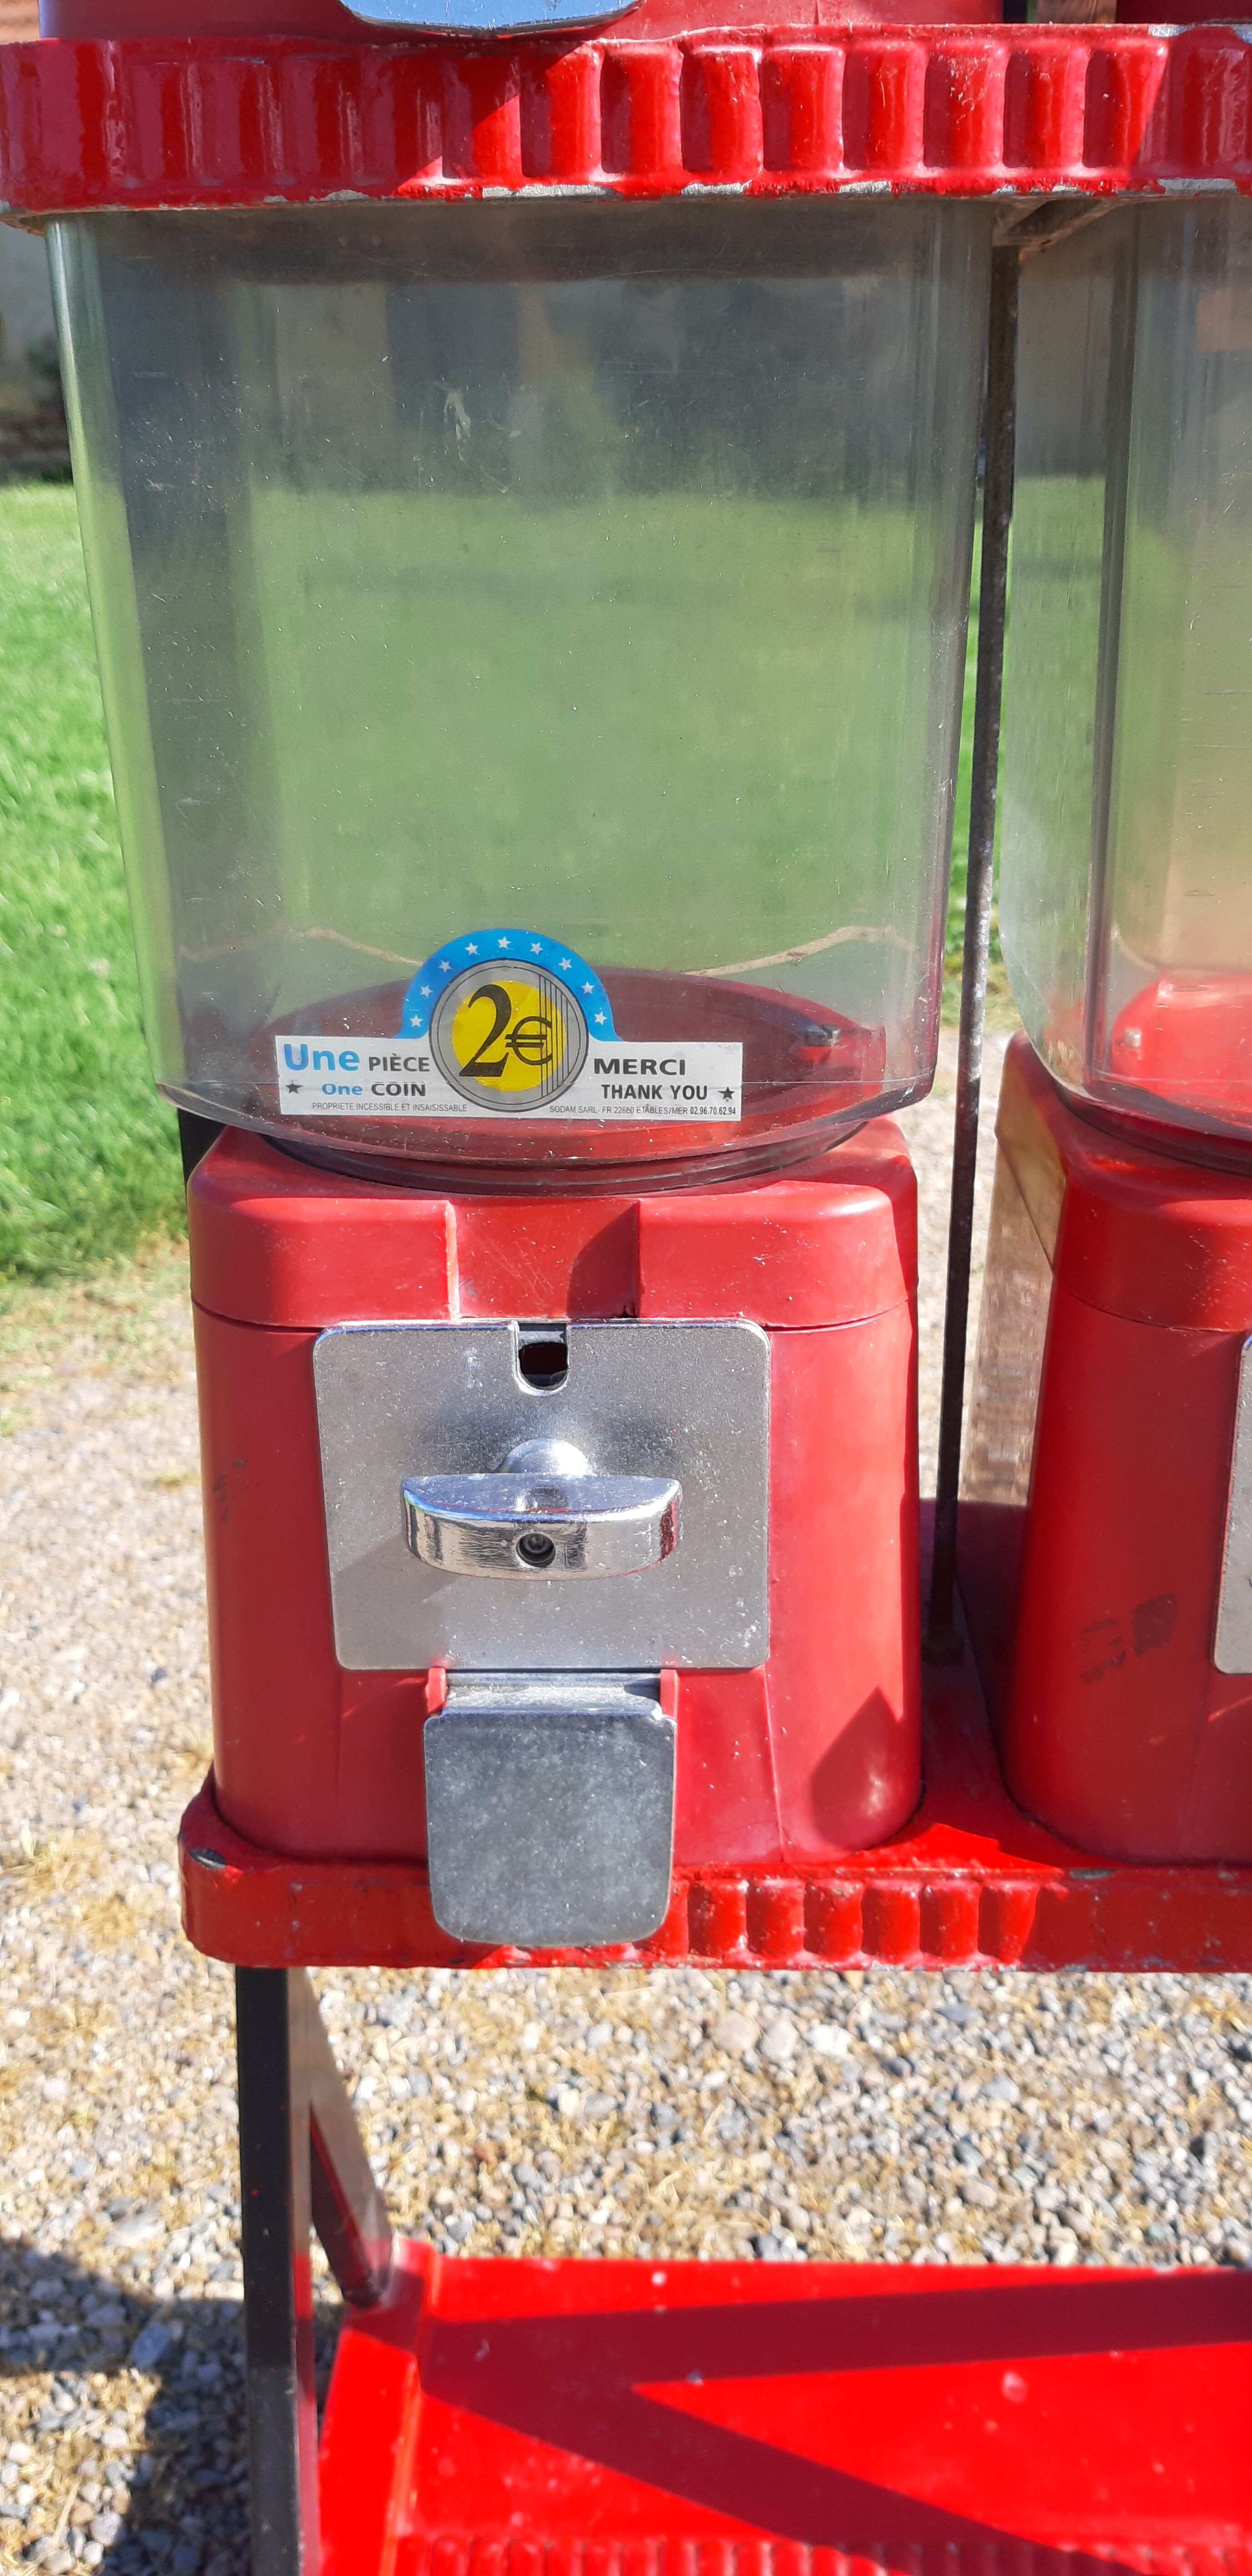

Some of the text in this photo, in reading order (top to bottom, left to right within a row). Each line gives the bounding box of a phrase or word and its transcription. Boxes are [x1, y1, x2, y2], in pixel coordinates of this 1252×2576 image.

[283, 1043, 430, 1072] Une PIÈCE
[594, 1058, 685, 1076] MERCI
[322, 1082, 426, 1097] One COIN
[601, 1084, 707, 1100] THANK YOU
[312, 1102, 354, 1110] PROPRIETE
[356, 1103, 399, 1111] INCESSIBLE
[413, 1103, 467, 1112] INSAISISSABLE
[550, 1105, 576, 1113] SODAM
[690, 1107, 736, 1115] 02.96.70.62.94
